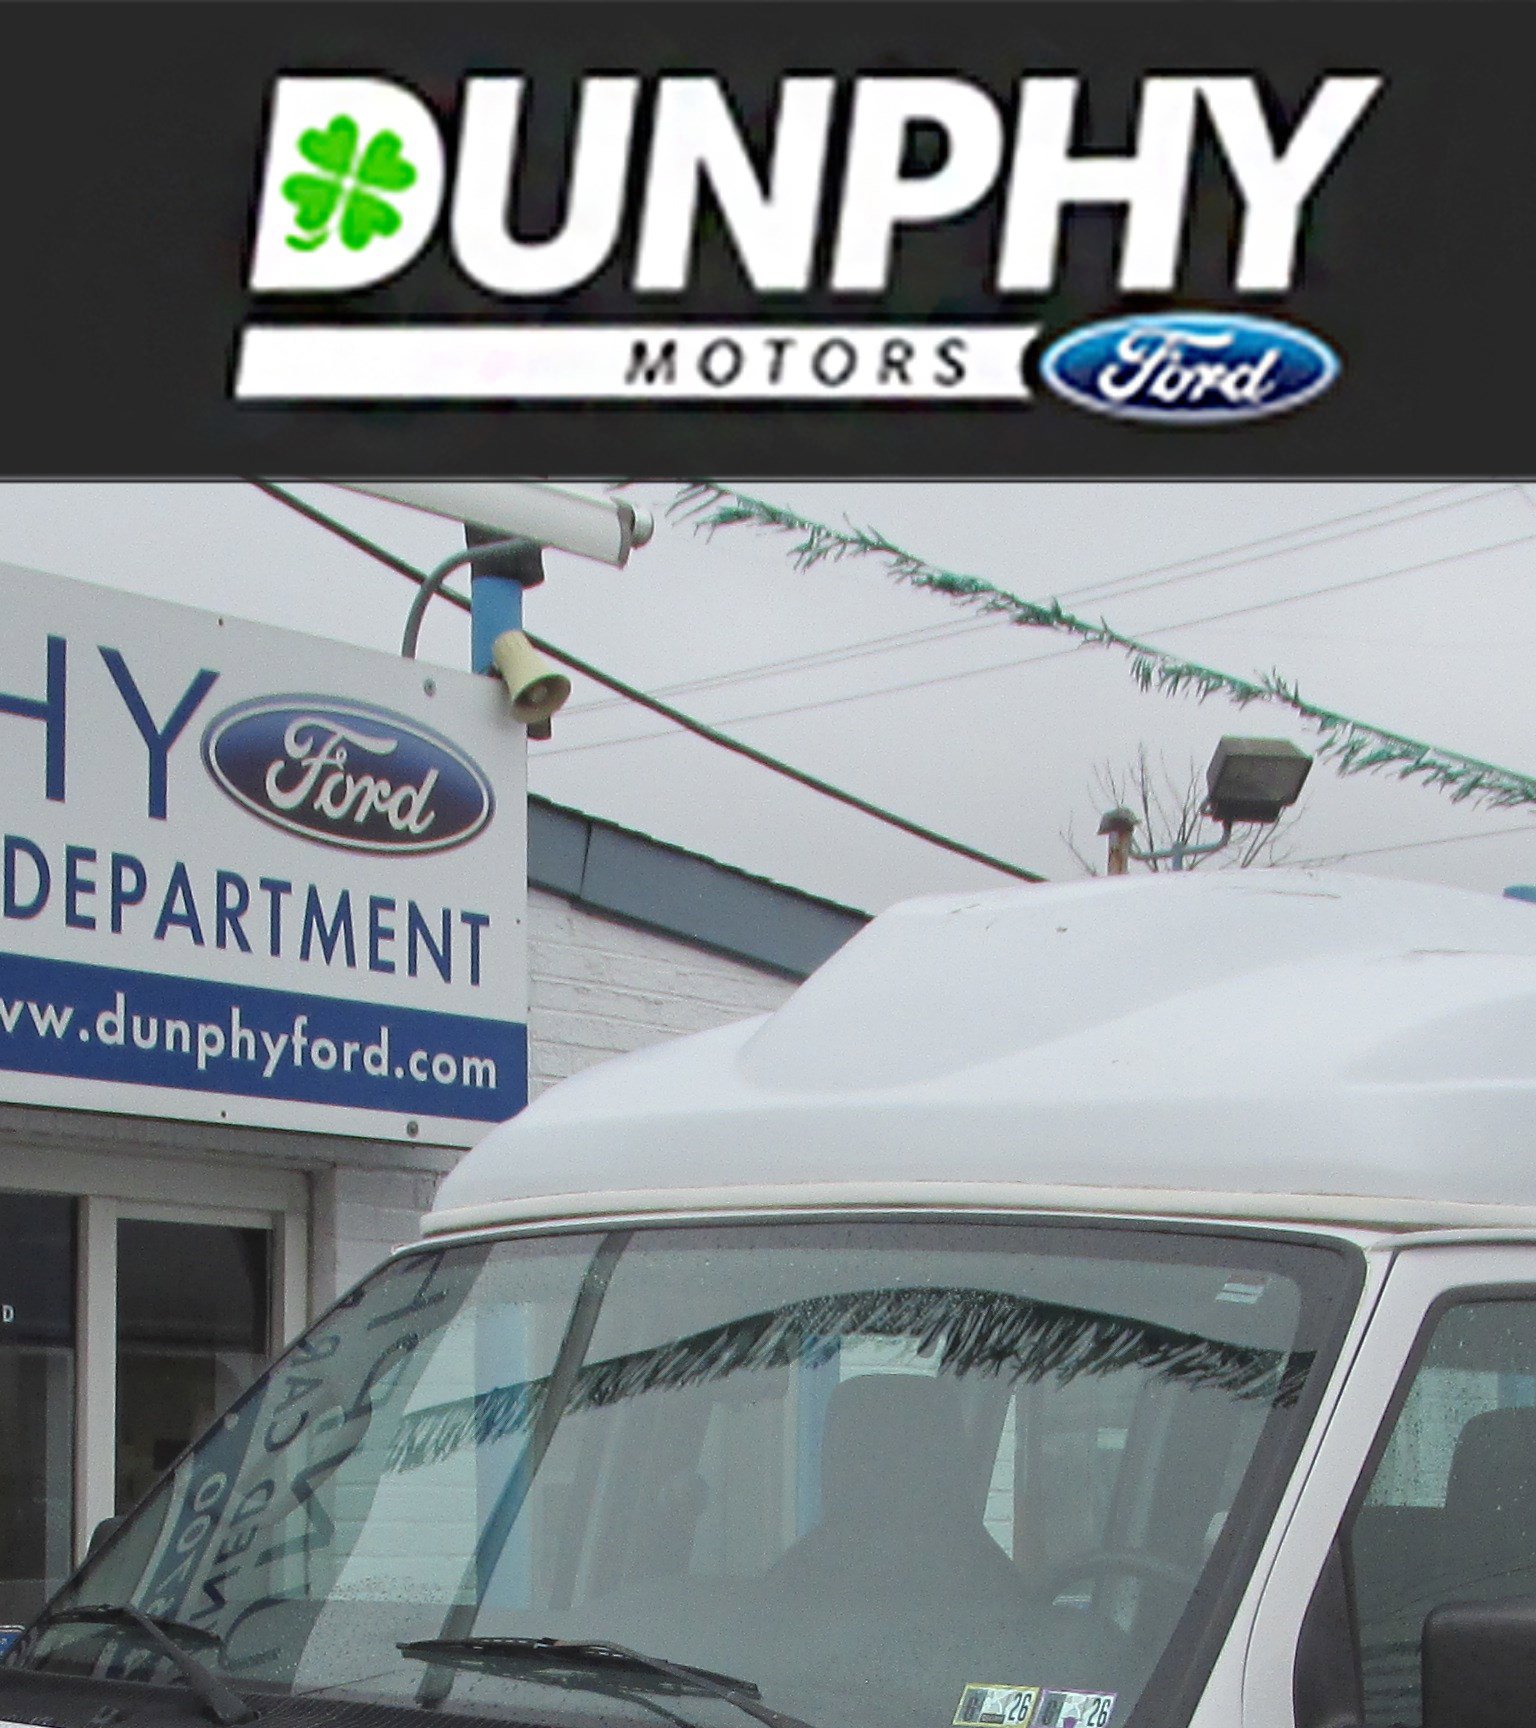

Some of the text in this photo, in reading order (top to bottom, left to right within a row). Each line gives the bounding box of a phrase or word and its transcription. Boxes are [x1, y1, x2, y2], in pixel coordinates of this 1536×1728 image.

[265, 717, 441, 834] Ford
[3, 834, 491, 987] DEPARTMENT
[1007, 1692, 1032, 1722] 26
[1086, 1697, 1112, 1728] 26
